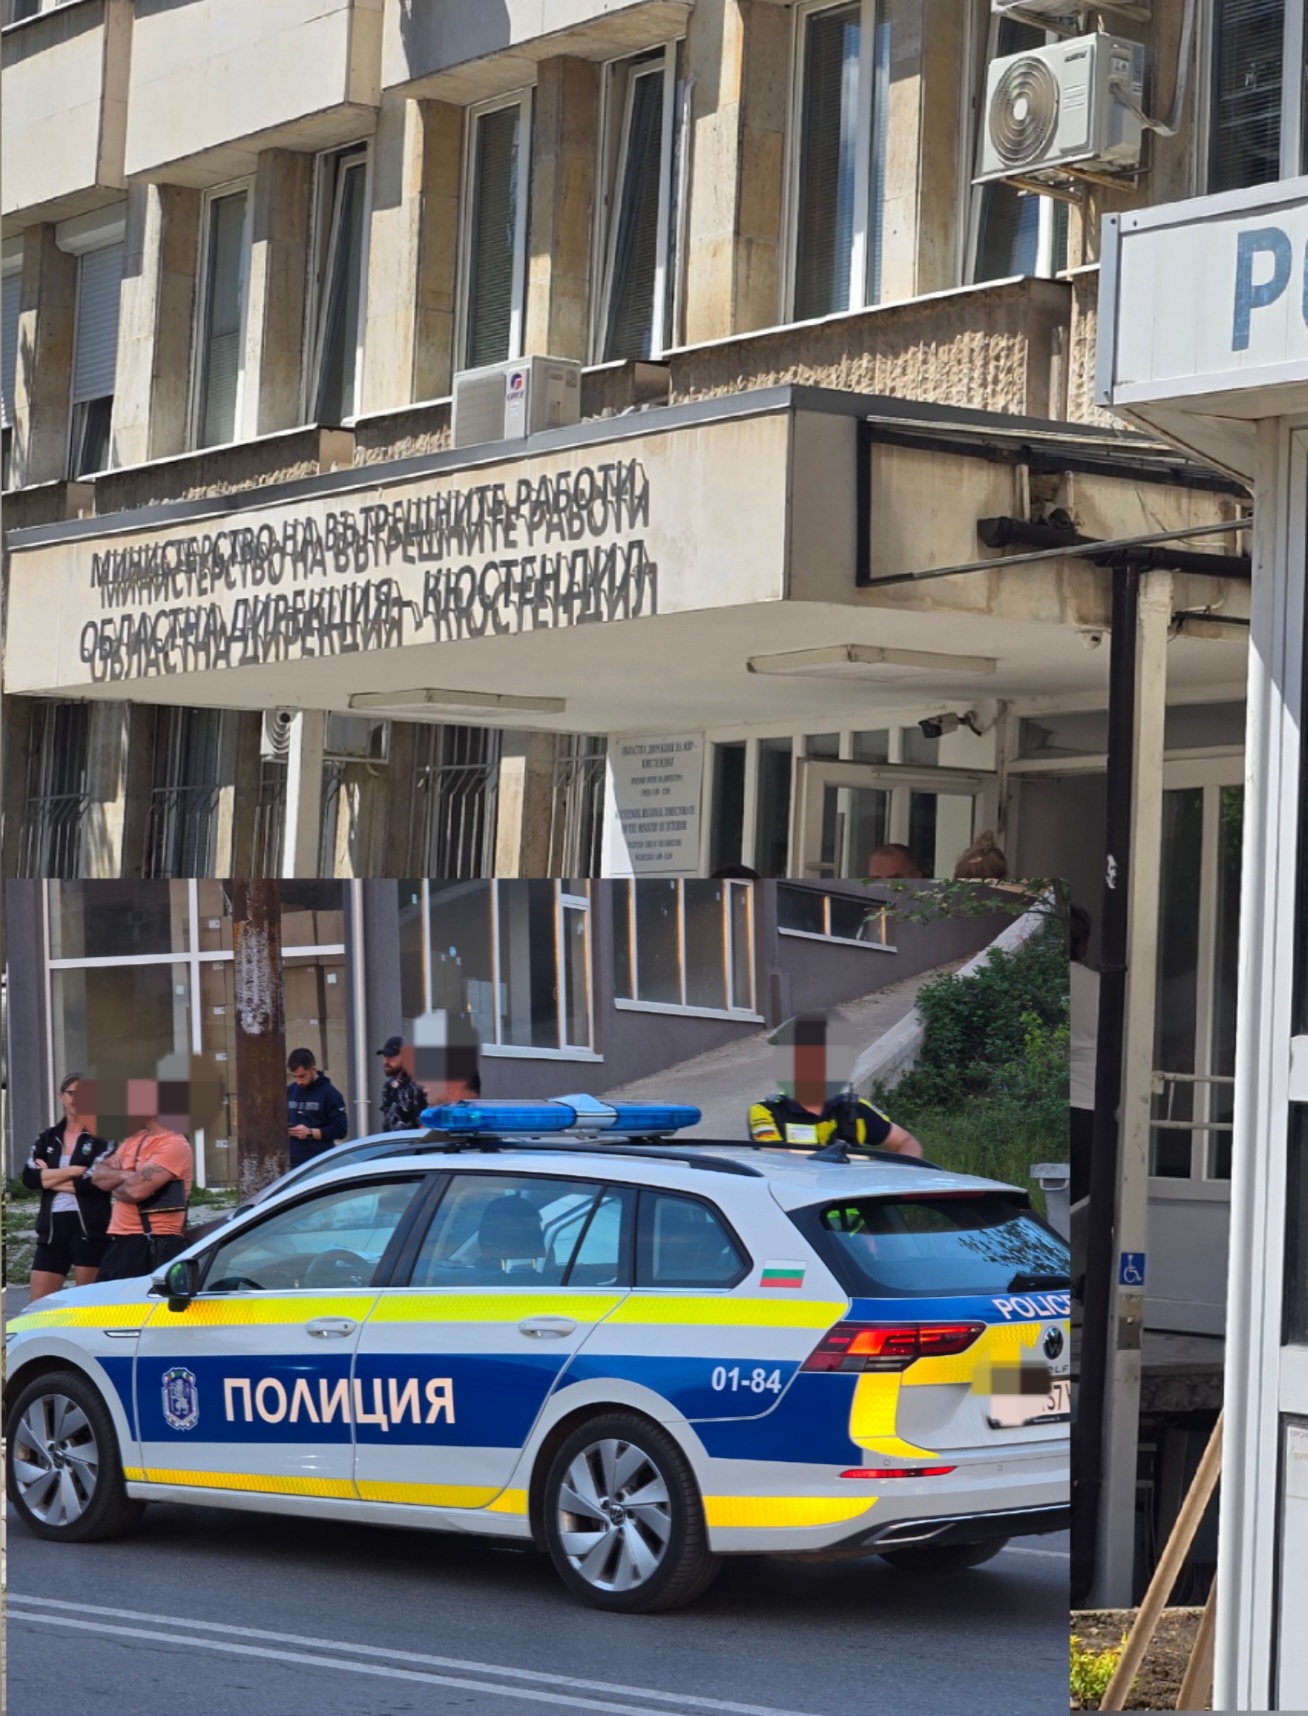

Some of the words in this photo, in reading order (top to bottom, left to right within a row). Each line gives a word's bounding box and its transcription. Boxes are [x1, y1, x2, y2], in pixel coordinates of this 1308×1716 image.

[91, 524, 274, 588] МИНИСТЕРСТВО
[283, 517, 321, 555] НА
[326, 484, 506, 551] ВЪТРЕШНИТЕ
[517, 458, 637, 518] РАБОТИ
[80, 602, 221, 663] ОБЛАСТНА
[228, 578, 392, 646] ДИРЕКЦИЯ
[424, 540, 645, 620] КЮСТЕНДИЛ
[224, 1377, 456, 1431] ПОЛИЦИЯ
[711, 1366, 782, 1394] 01-84
